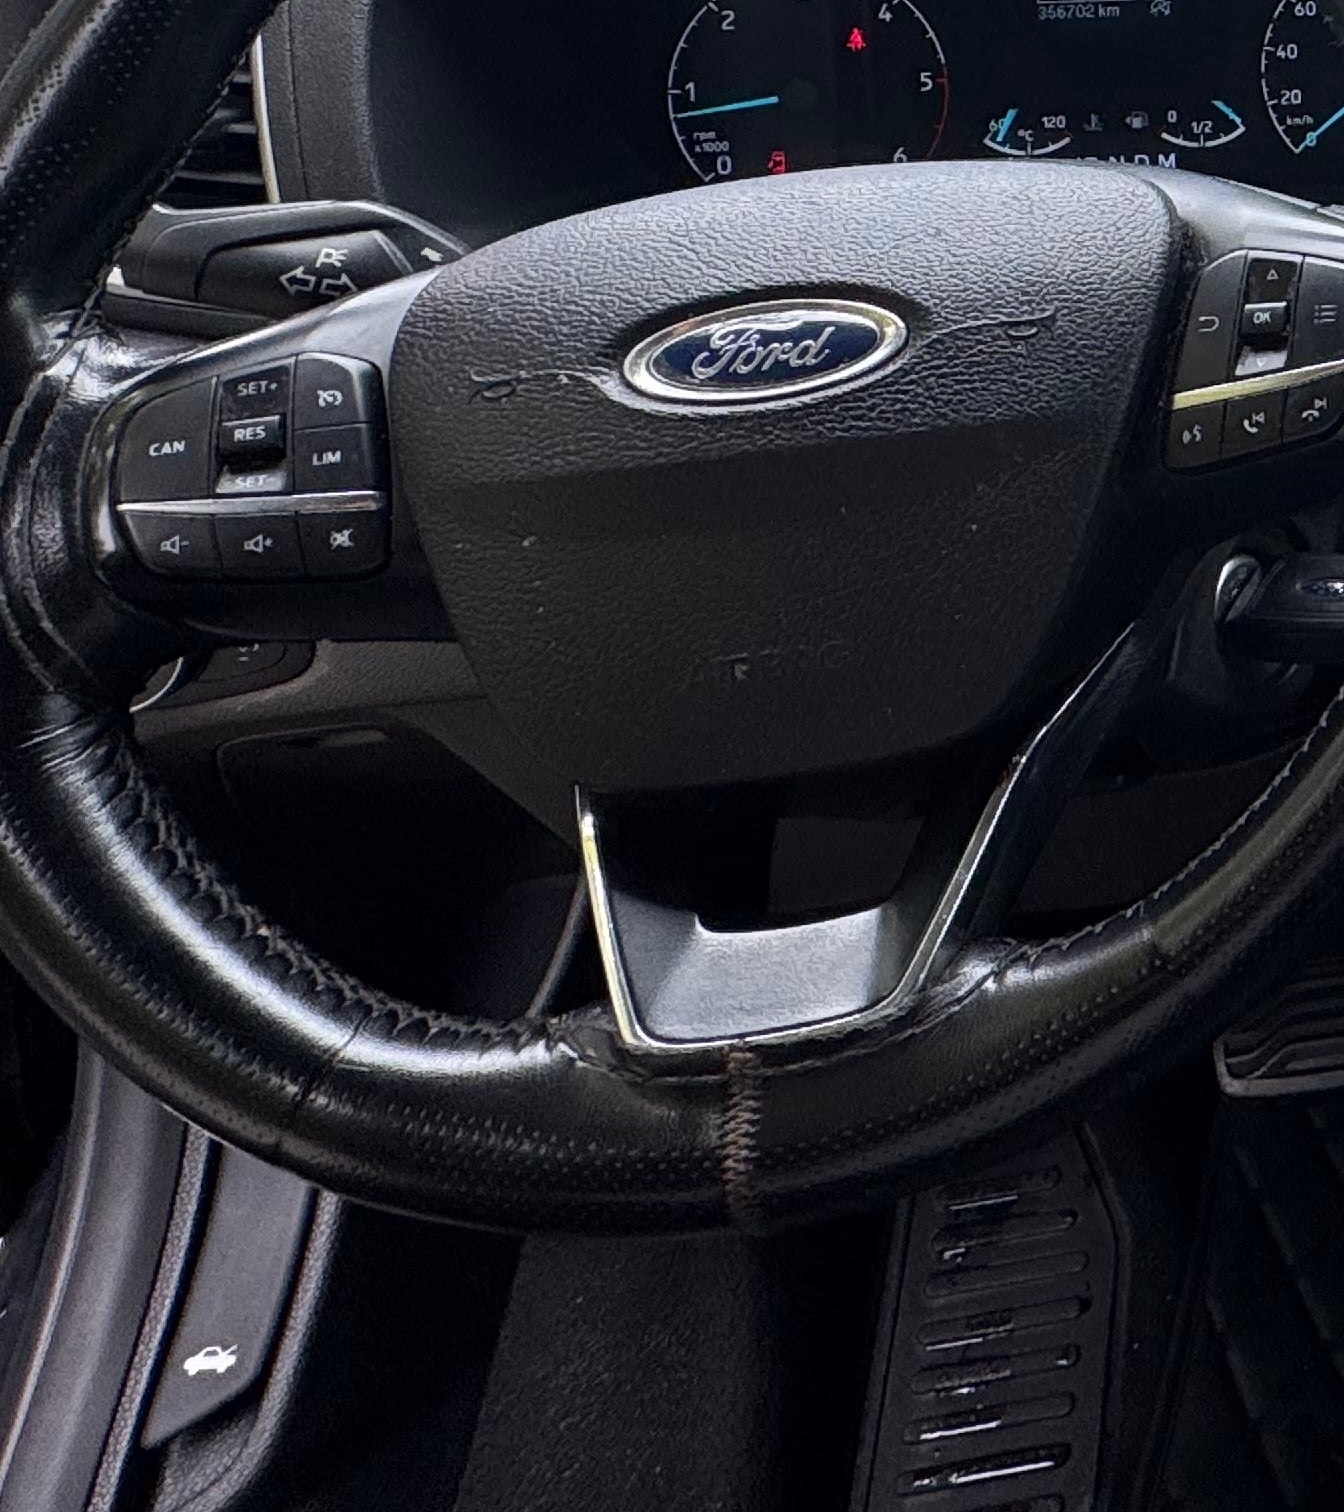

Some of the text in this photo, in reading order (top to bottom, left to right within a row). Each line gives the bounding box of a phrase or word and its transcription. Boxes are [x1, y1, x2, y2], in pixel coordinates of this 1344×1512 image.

[878, 2, 893, 23] 4
[1098, 4, 1121, 18] km
[1294, 0, 1317, 17] 60
[721, 9, 736, 31] 2
[1276, 43, 1299, 60] 40
[920, 71, 934, 93] 5
[684, 81, 697, 103] 1
[1280, 89, 1303, 106] 20
[1041, 115, 1067, 129] 120
[1167, 109, 1178, 124] 0
[1286, 114, 1315, 127] km/h
[1190, 119, 1214, 135] 1/2
[716, 154, 733, 176] 0
[1158, 152, 1176, 169] M
[1253, 310, 1272, 325] OK
[690, 324, 837, 380] Ford
[237, 379, 278, 397] SET+
[233, 425, 267, 443] RES
[148, 439, 186, 457] CAN
[312, 449, 342, 467] LIM
